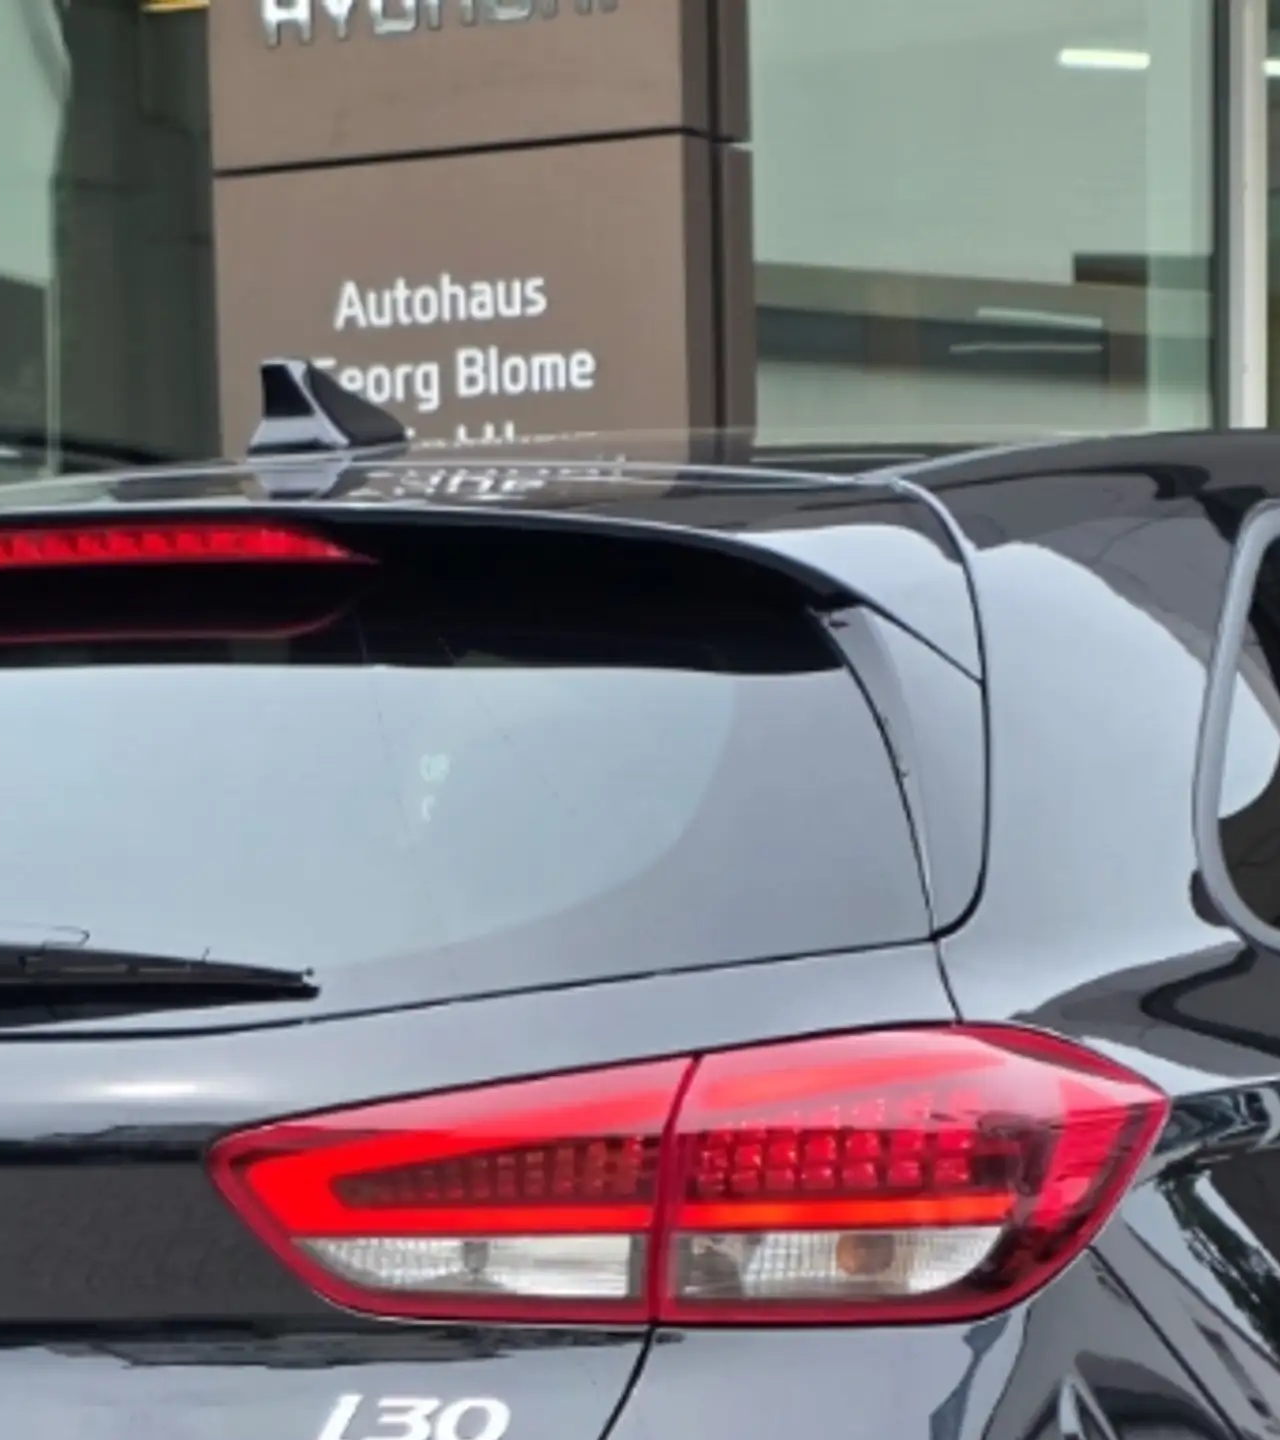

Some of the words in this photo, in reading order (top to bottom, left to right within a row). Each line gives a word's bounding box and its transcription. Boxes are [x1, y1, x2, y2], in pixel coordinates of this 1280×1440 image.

[333, 272, 548, 331] Autohaus
[311, 356, 441, 413] eorg
[455, 344, 596, 398] Blome
